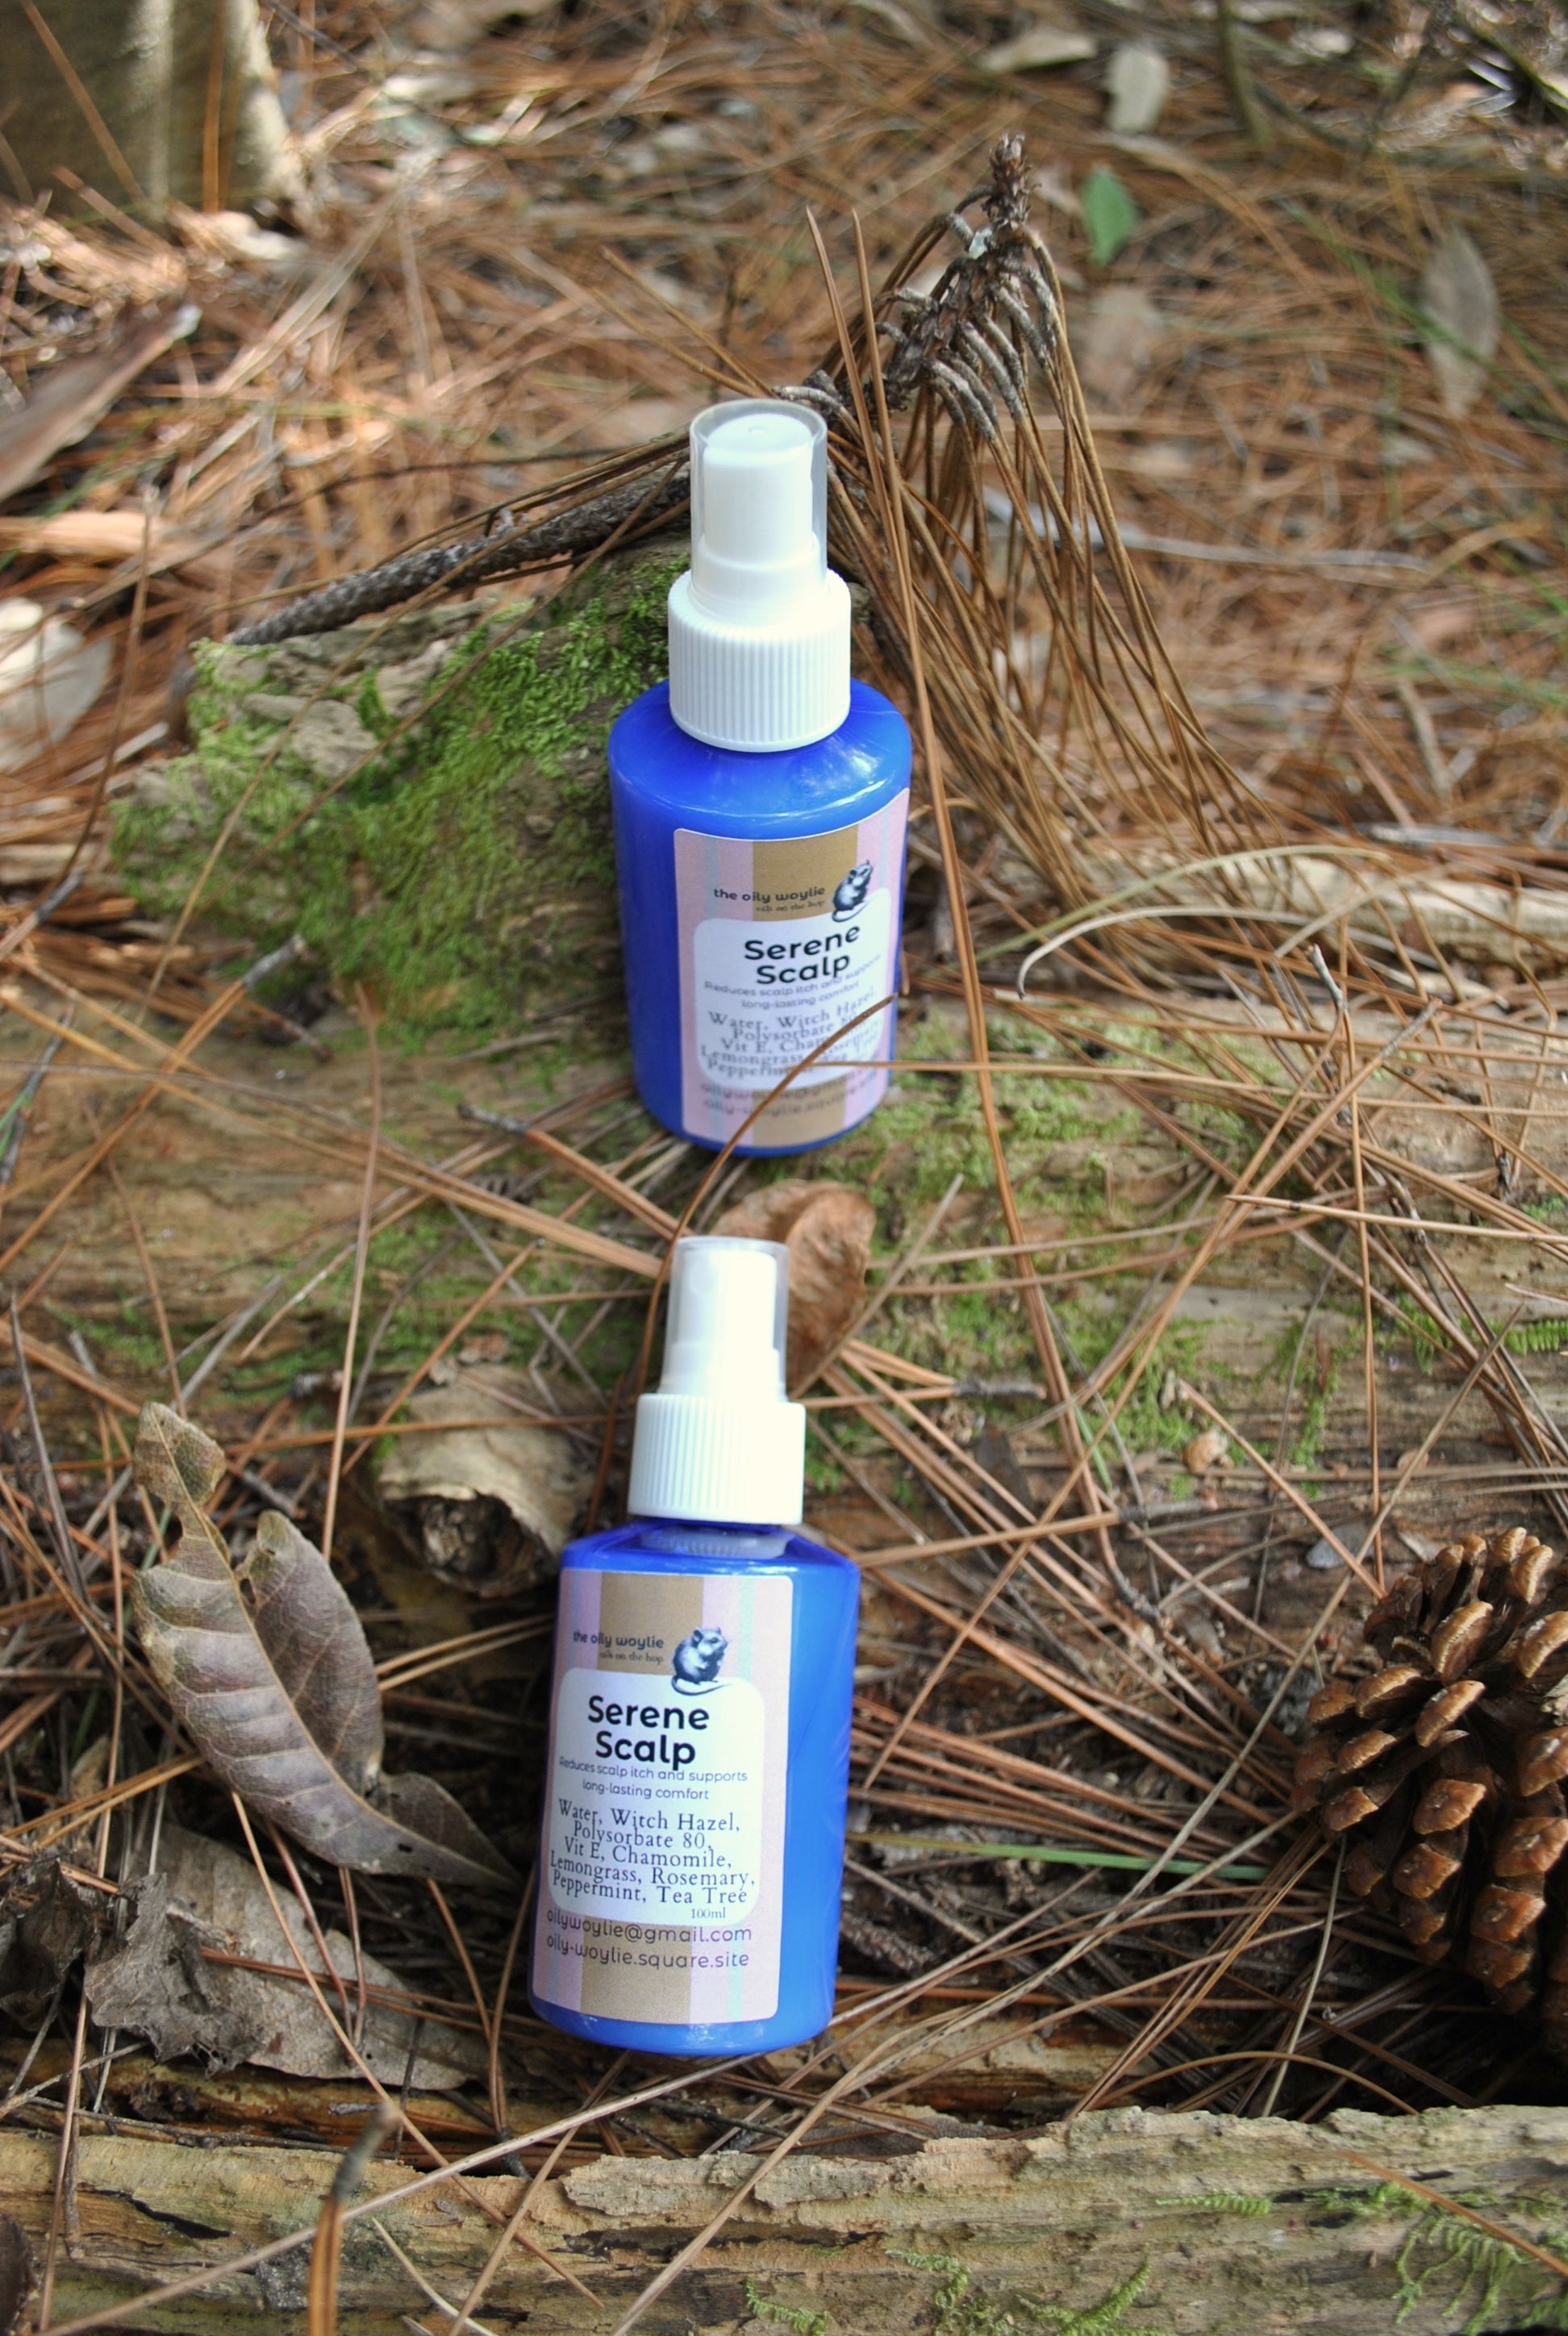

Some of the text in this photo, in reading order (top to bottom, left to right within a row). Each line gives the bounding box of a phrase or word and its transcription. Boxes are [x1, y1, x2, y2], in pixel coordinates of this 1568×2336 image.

[714, 886, 825, 904] the oily woylie
[744, 926, 861, 960] Serene
[757, 954, 850, 985] Scalp
[705, 981, 756, 996] Reduces
[759, 983, 794, 997] scalp
[796, 981, 818, 995] itch
[742, 994, 815, 1009] long-lasting
[708, 1011, 768, 1030] Water,
[777, 1011, 829, 1030] Witch
[732, 1021, 834, 1042] Polysorbate
[721, 1037, 746, 1052] Vit
[573, 1631, 664, 1650] the oily woylie
[629, 1652, 643, 1662] the
[645, 1652, 664, 1666] hop
[587, 1696, 710, 1730] Serene
[595, 1730, 695, 1771] Scalp
[559, 1756, 748, 1783] Reduces scalp itch and supports
[582, 1779, 709, 1800] long-lasting comfort
[558, 1798, 740, 1832] Water, Witch Hazel,
[573, 1820, 712, 1850] Polysorbate 80,
[565, 1836, 732, 1868] Vit E, Chamomile,
[551, 1850, 755, 1891] Lemongrass, Rosemary,
[553, 1869, 747, 1904] Peppermint, Tea Tree
[547, 1909, 752, 1944] oilywoylie@gmail.com
[690, 1907, 726, 1920] 100ml
[547, 1933, 749, 1970] oily-woylie.square.site
